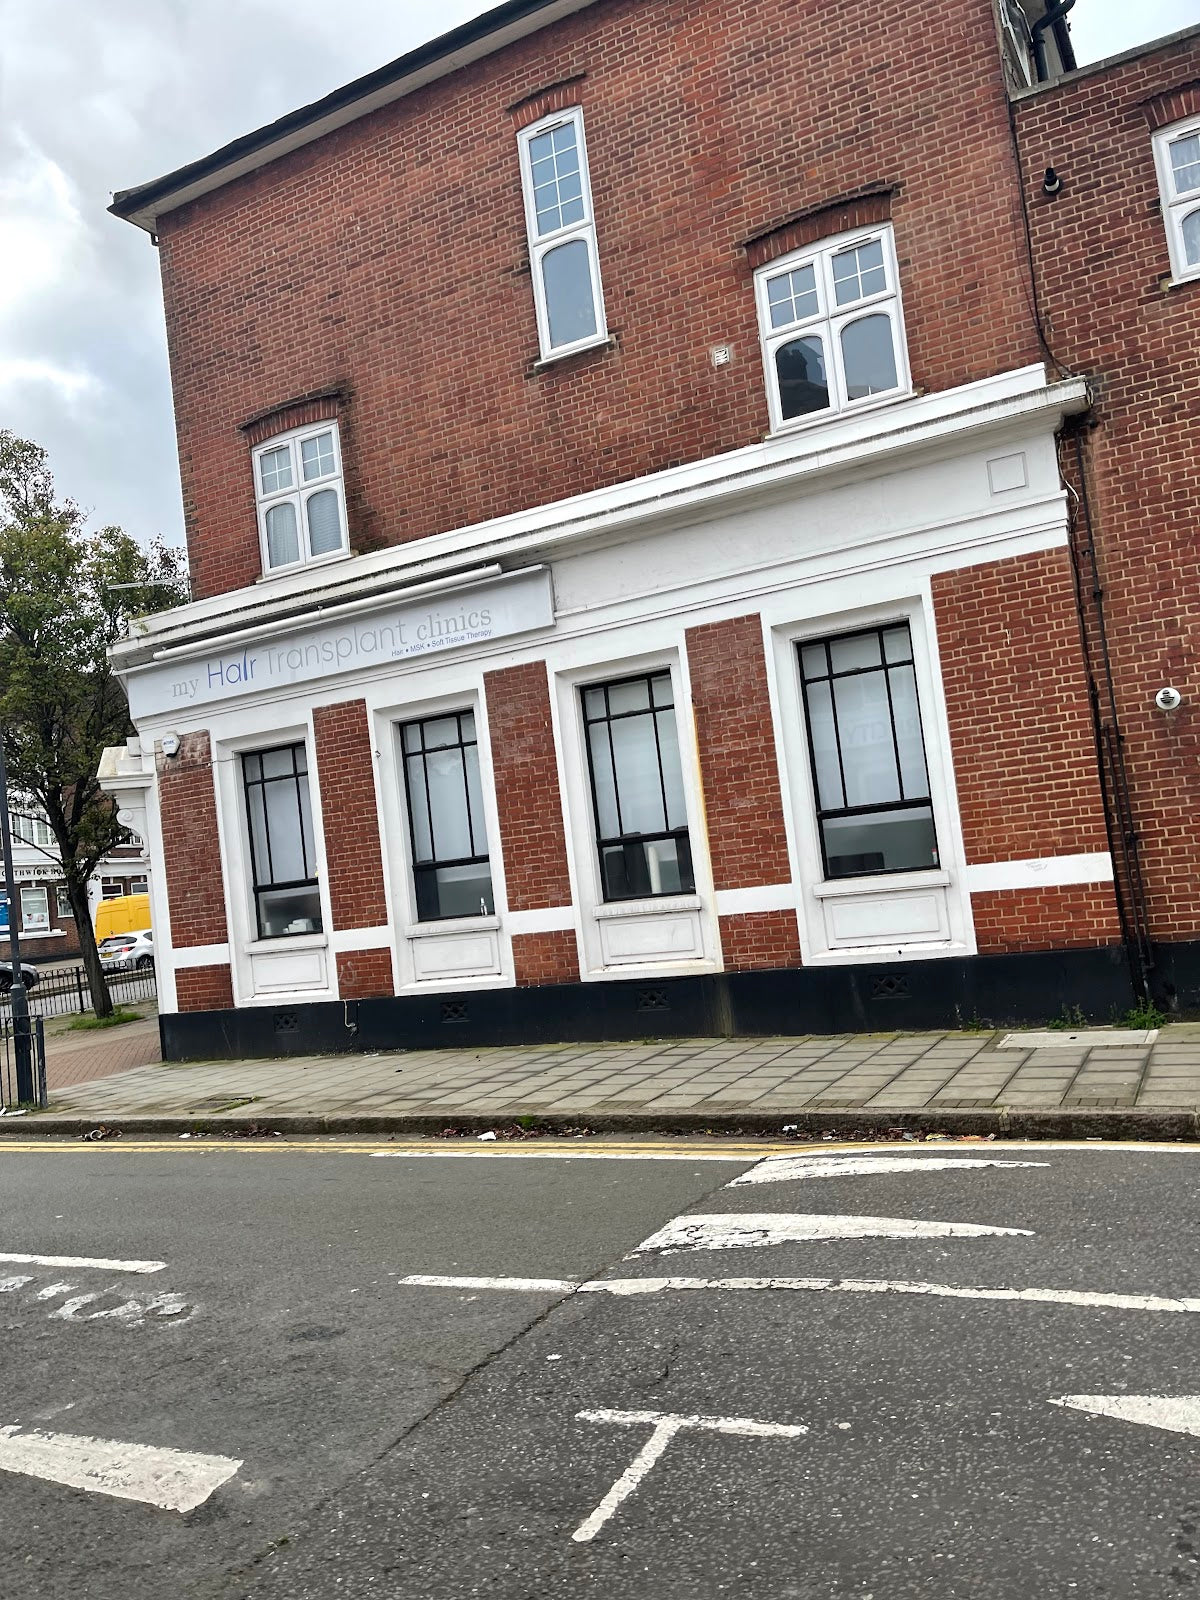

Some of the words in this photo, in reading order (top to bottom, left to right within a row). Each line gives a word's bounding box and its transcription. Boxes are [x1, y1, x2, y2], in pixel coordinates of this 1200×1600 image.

[172, 678, 199, 699] my
[207, 648, 257, 689] Hair
[262, 620, 407, 674] Transplant
[417, 606, 491, 640] clinics
[391, 649, 404, 657] Hair
[410, 642, 425, 653] MSK
[431, 638, 444, 649] Soft
[445, 634, 465, 645] Tissue
[466, 628, 492, 640] Therapy
